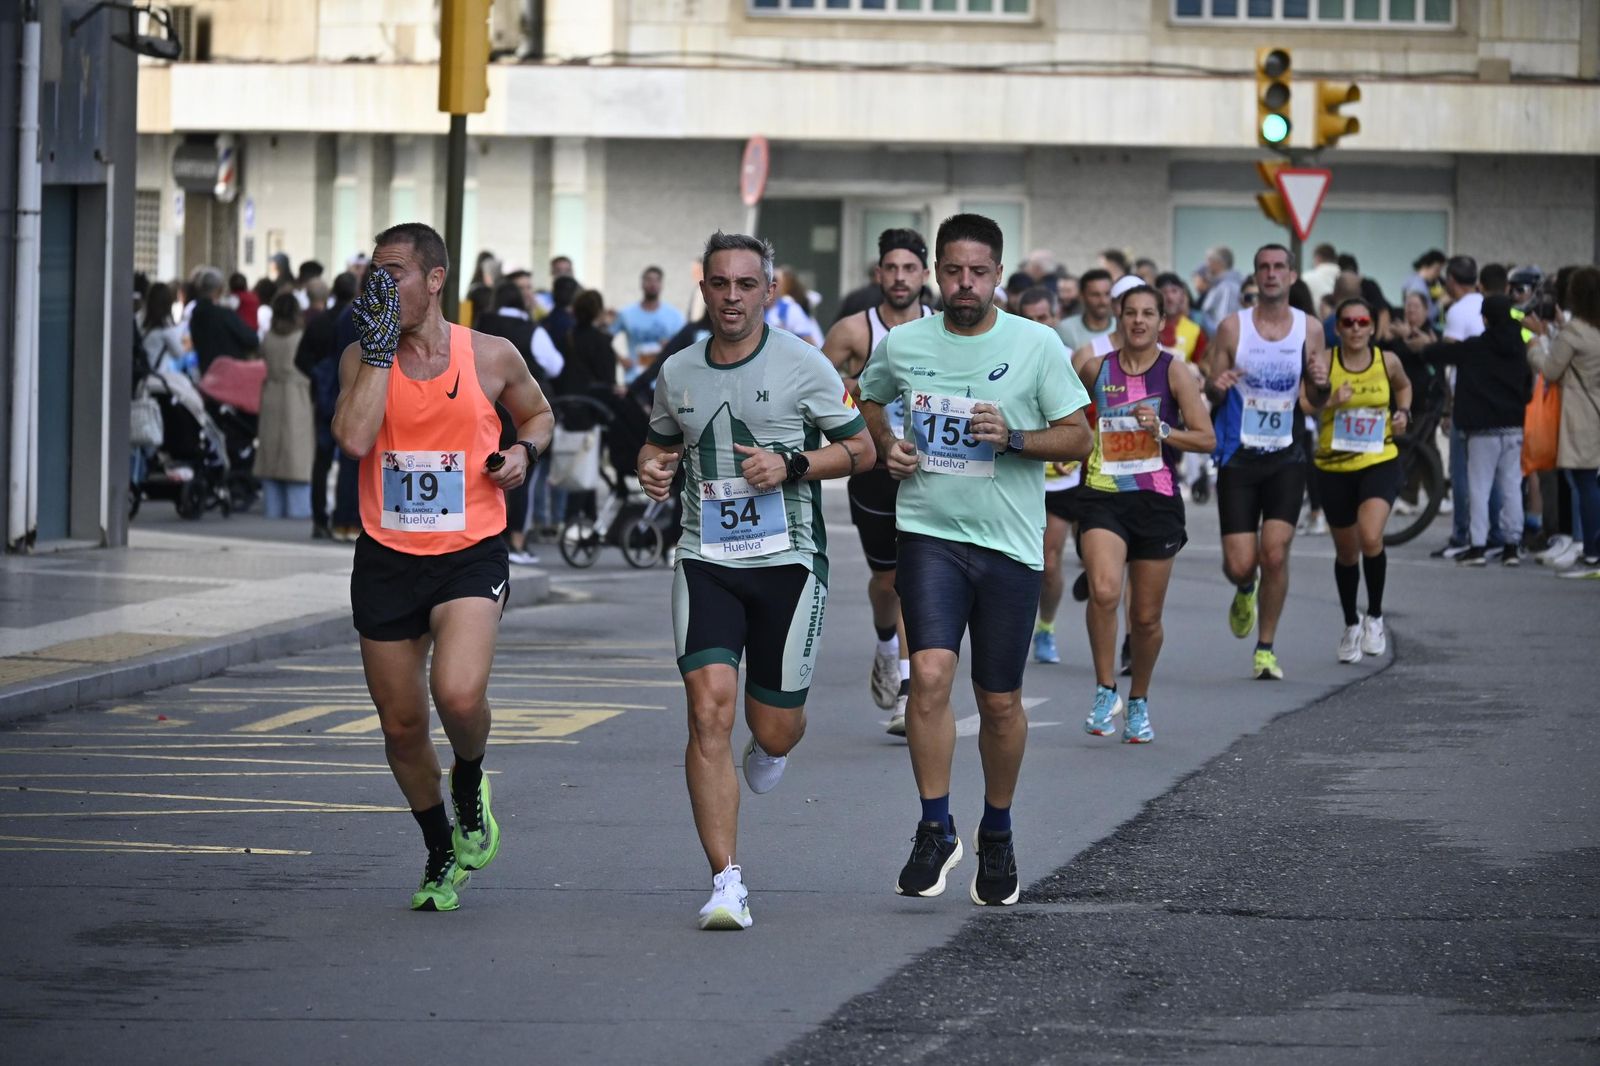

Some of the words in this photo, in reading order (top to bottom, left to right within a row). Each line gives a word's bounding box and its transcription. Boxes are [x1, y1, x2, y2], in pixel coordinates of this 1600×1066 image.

[915, 394, 931, 408] 2K
[1257, 410, 1281, 429] 76
[1344, 416, 1377, 436] 157
[923, 414, 980, 448] 155
[1111, 432, 1147, 452] 387
[441, 453, 458, 466] 2K
[927, 457, 965, 469] Huelva
[401, 473, 438, 501] 19
[703, 482, 716, 495] 2K
[399, 514, 436, 524] Huelva
[721, 497, 760, 530] 54
[723, 541, 761, 552] Huelva
